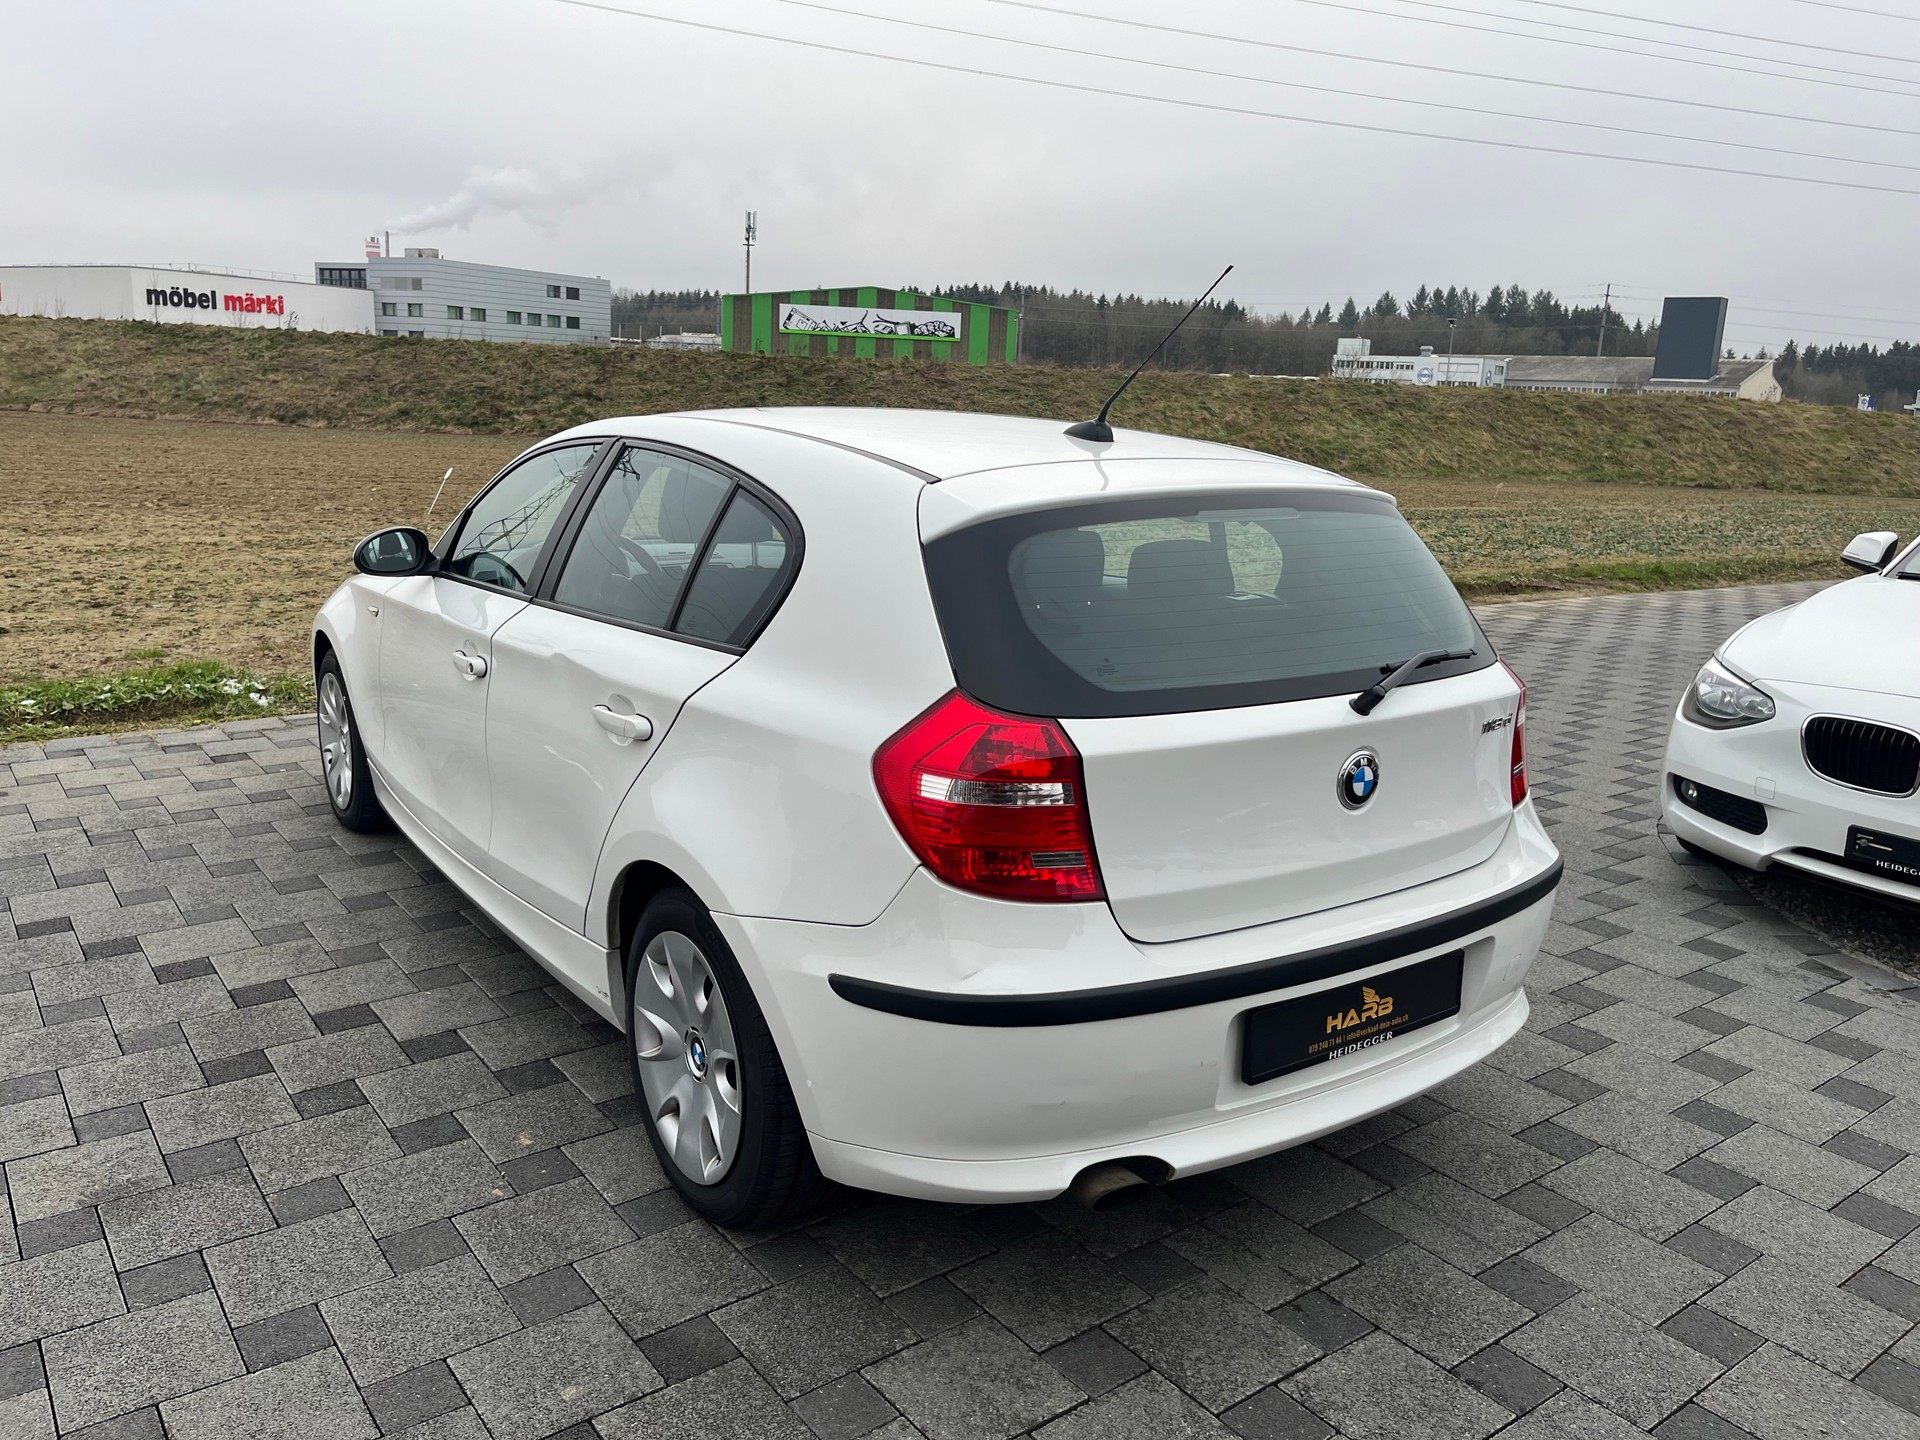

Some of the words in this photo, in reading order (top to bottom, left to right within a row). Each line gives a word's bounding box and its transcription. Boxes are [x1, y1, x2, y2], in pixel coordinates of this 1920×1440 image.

[146, 286, 217, 310] möbel
[223, 292, 285, 315] märki
[1350, 757, 1377, 775] BMW
[1876, 860, 1920, 876] HEIDEG
[1326, 996, 1394, 1034] HARB
[1308, 1043, 1318, 1054] 079
[1328, 1031, 1394, 1060] HEIDEGGER
